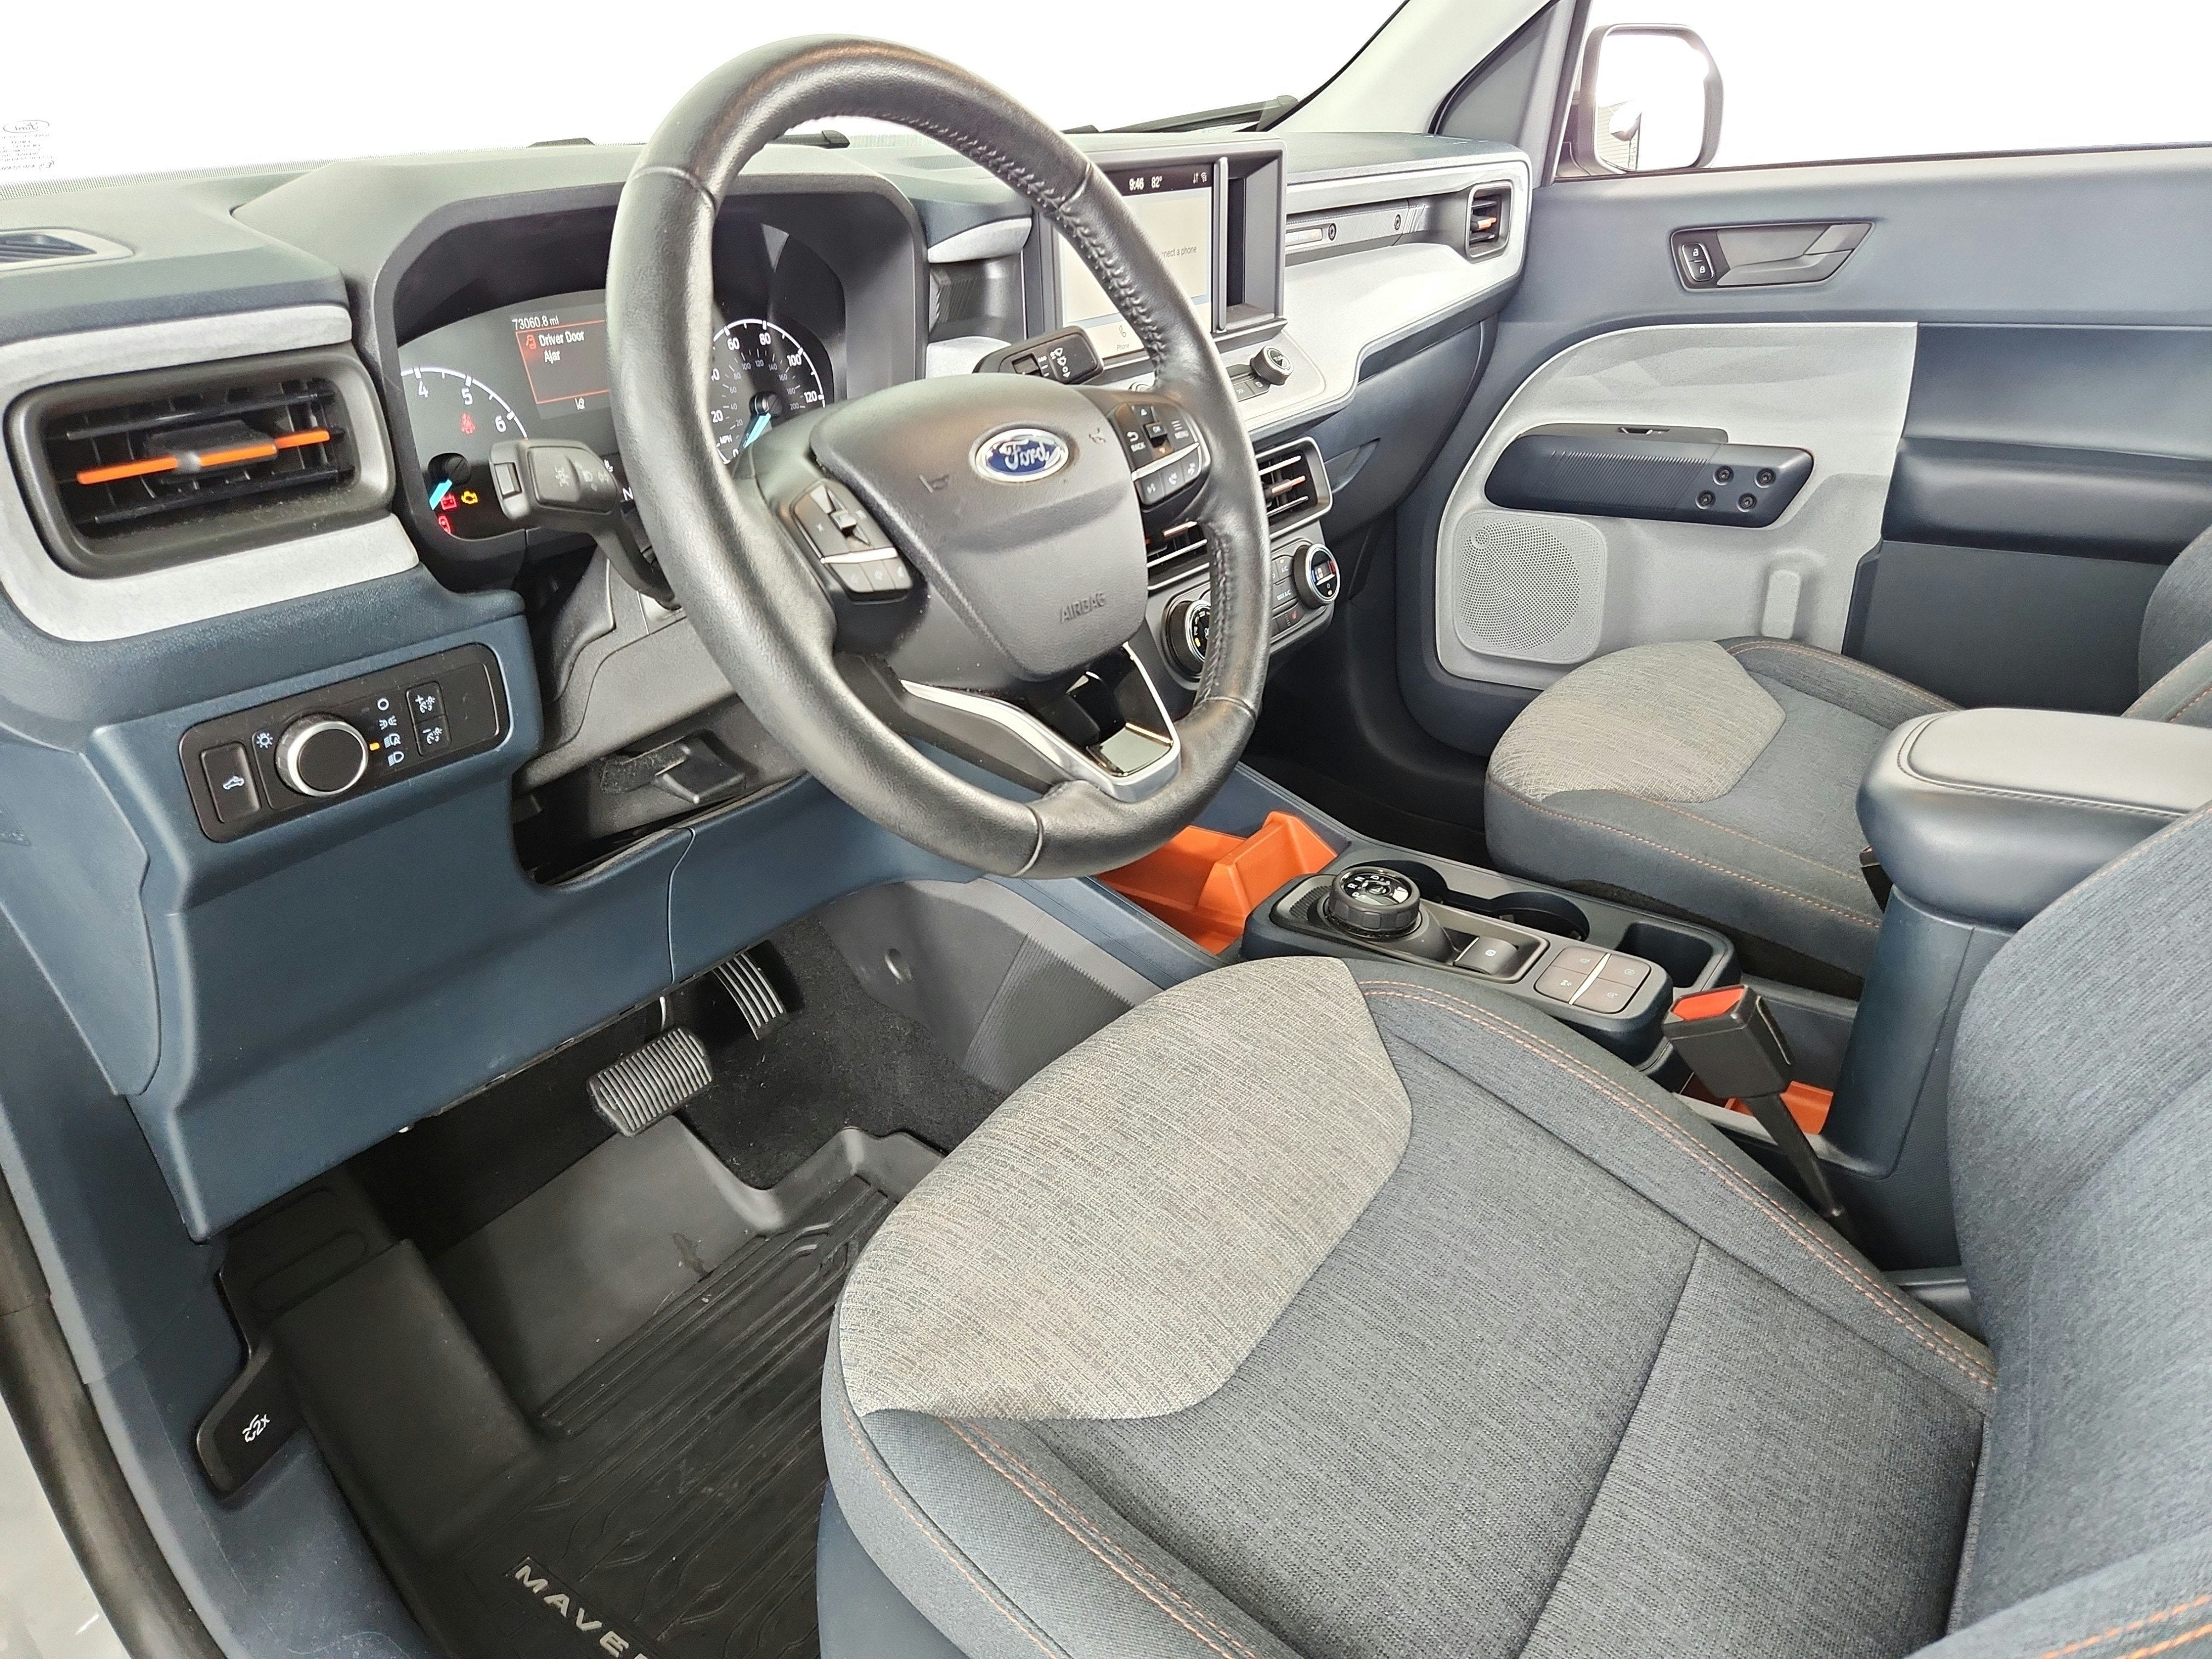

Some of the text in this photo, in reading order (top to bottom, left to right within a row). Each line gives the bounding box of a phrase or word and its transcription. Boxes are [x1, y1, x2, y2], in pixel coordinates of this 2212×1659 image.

[1129, 177, 1144, 191] 9:46
[1181, 246, 1197, 257] phone
[512, 315, 549, 330] 73060.8
[538, 331, 584, 347] Driver Door
[727, 337, 740, 351] 60
[759, 332, 771, 345] 80
[544, 349, 561, 364] Ajar
[787, 354, 802, 367] 100
[711, 368, 720, 381] 0
[418, 381, 429, 398] 4
[461, 387, 473, 405] 5
[804, 391, 817, 403] 120
[711, 409, 724, 422] 20
[495, 415, 507, 432] 6
[736, 419, 743, 427] 20
[719, 434, 733, 444] MPH
[998, 438, 1049, 471] Ford
[622, 487, 634, 501] N
[1059, 592, 1105, 623] AIRBAG
